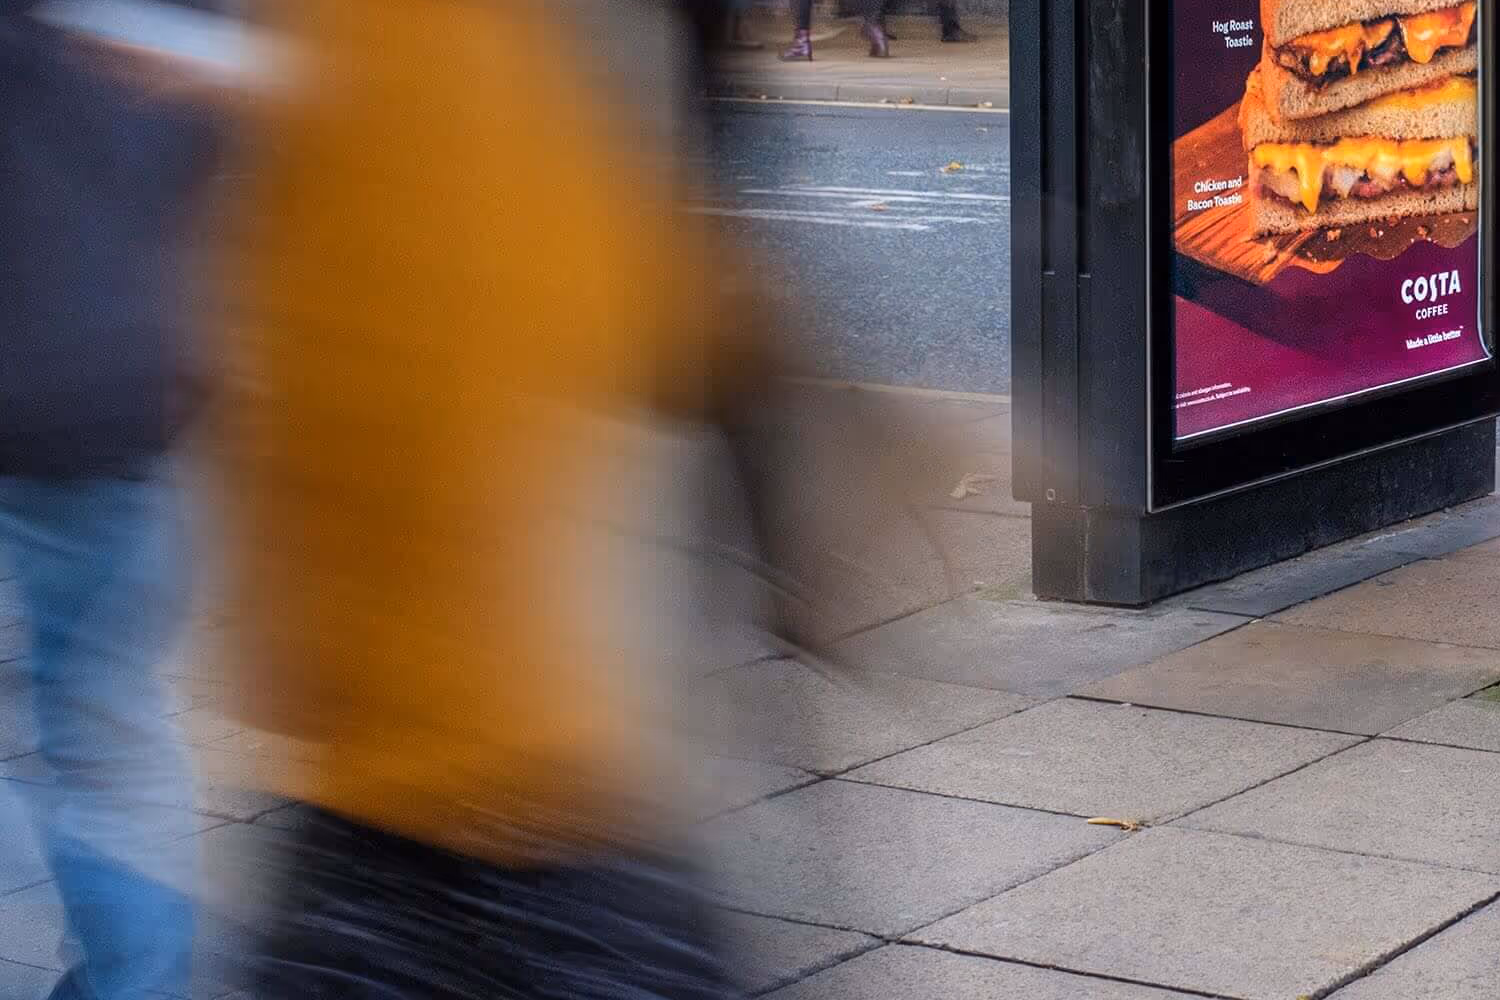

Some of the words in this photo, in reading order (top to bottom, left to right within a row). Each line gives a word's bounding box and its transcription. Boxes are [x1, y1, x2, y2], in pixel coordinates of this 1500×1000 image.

[1212, 20, 1229, 34] Hog
[1229, 19, 1254, 31] Roast
[1224, 36, 1253, 49] Toastie
[1194, 179, 1228, 194] Chicken
[1228, 176, 1242, 188] and
[1187, 198, 1213, 211] Bacon
[1213, 192, 1242, 207] Toastie
[1401, 269, 1461, 304] COSTA
[1415, 303, 1449, 320] COFFEE
